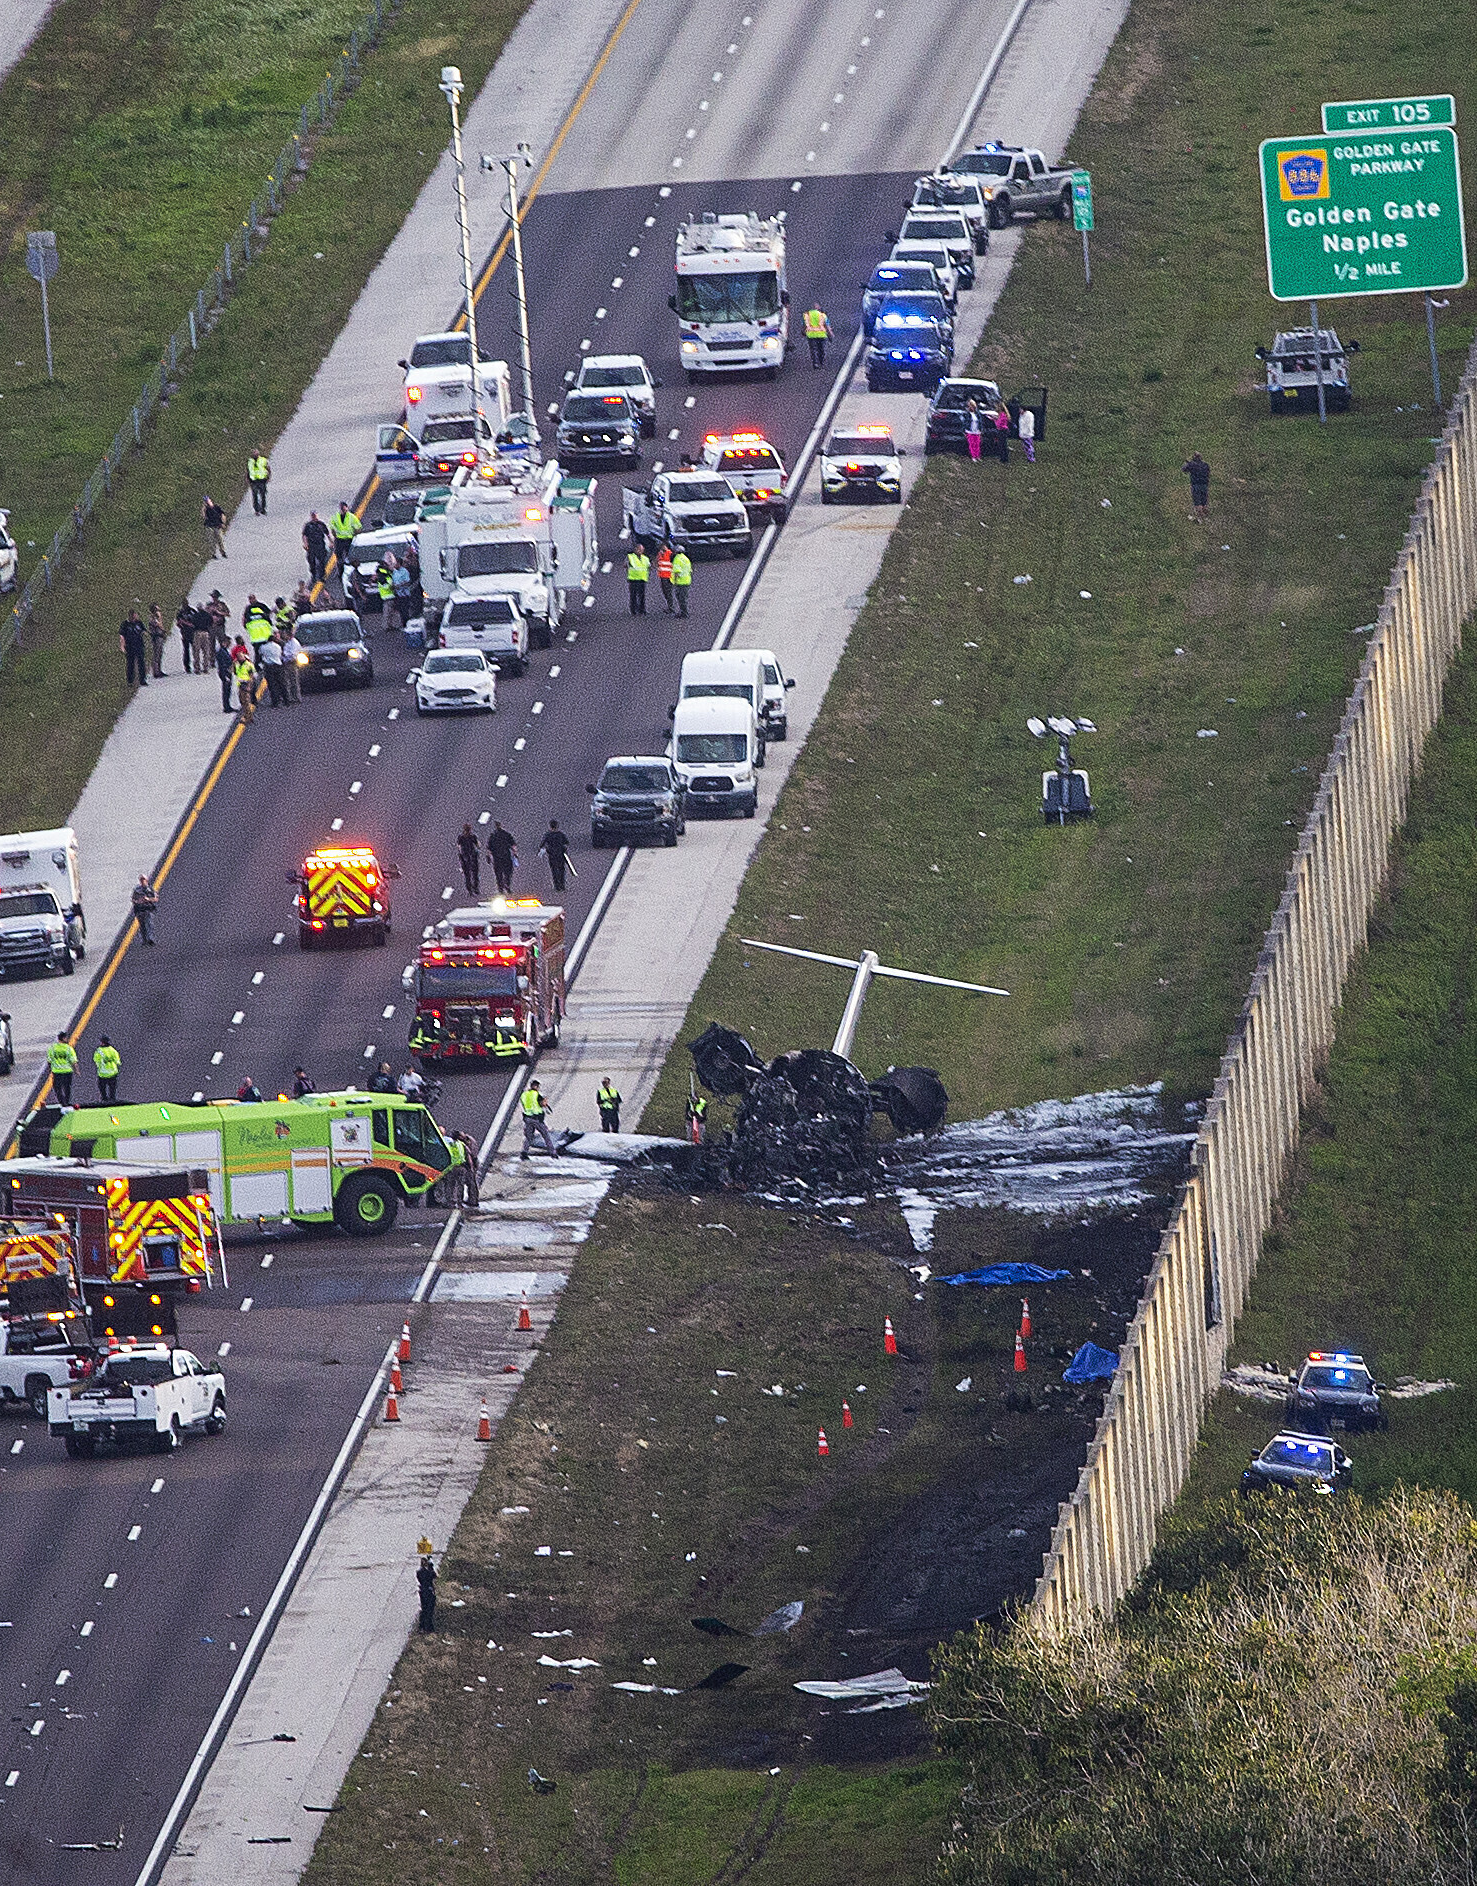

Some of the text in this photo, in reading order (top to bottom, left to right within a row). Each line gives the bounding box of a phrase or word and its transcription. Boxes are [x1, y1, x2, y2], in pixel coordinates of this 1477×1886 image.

[1346, 103, 1431, 124] EXIT 105
[1333, 139, 1442, 160] GOLDEN GATE
[1350, 158, 1425, 176] PARKWAY
[1286, 199, 1441, 228] Golden Gate
[1322, 230, 1409, 255] Naples
[1333, 260, 1402, 281] 1/2 MILE
